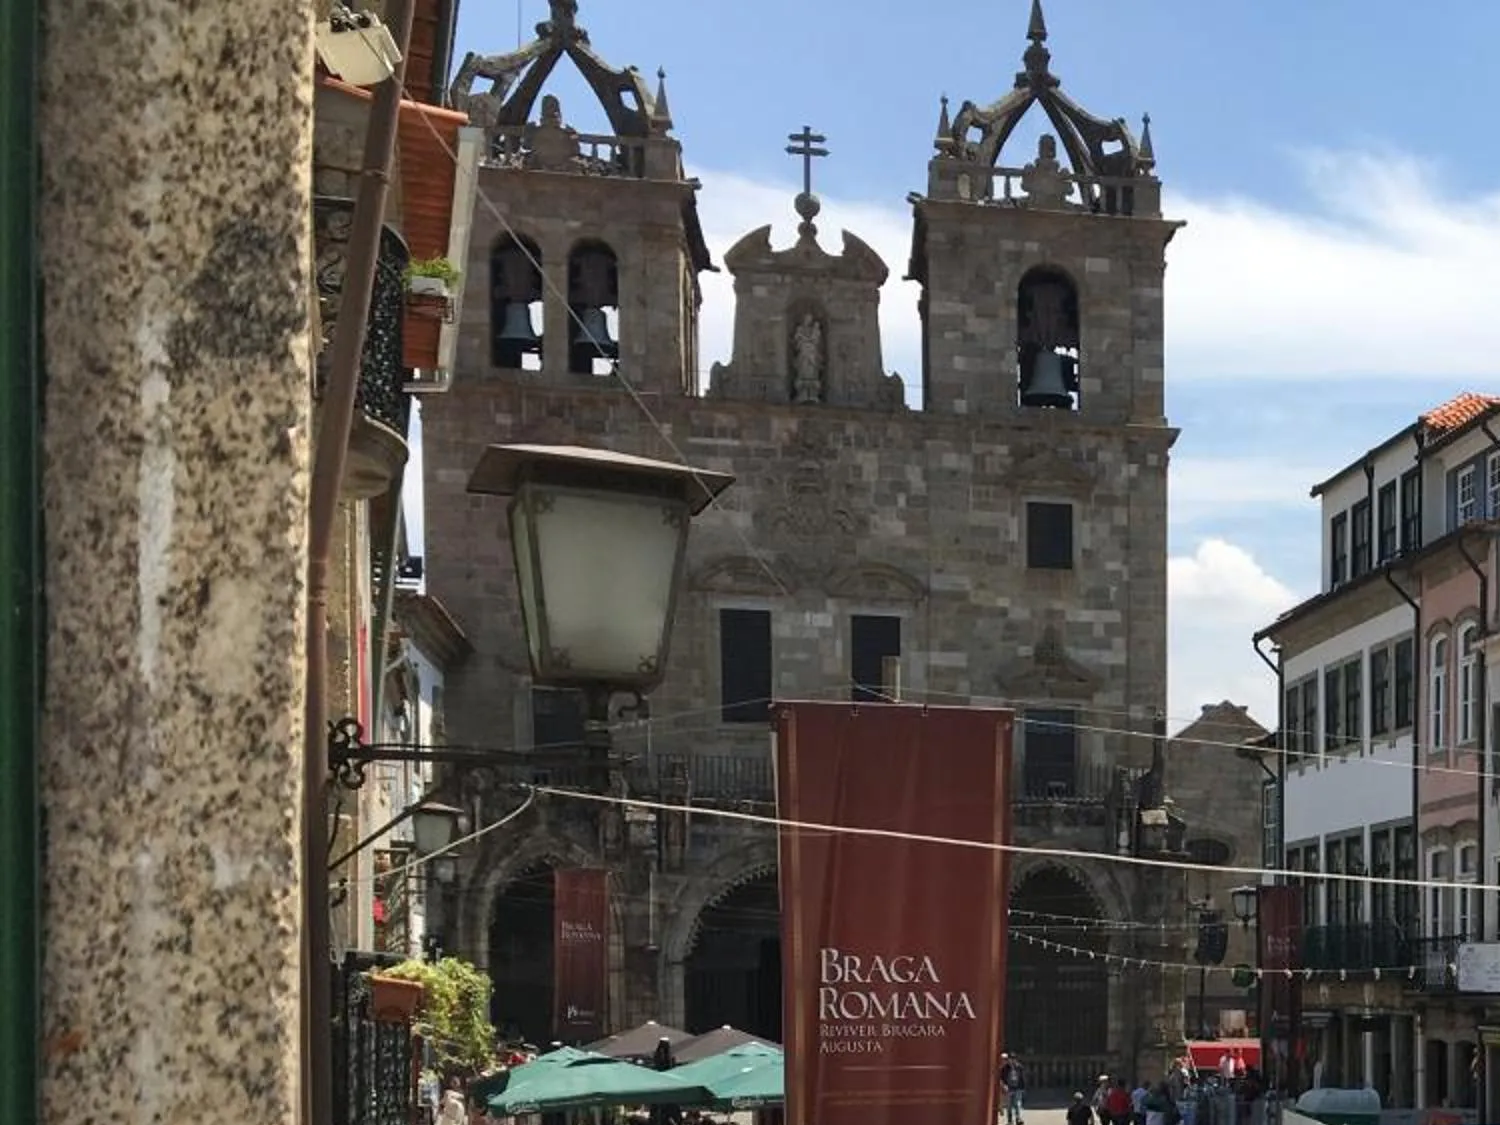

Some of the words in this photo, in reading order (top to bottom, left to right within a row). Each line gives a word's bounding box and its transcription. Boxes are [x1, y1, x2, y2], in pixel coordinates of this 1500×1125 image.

[820, 948, 940, 983] BRAGA
[819, 986, 977, 1020] ROMANA
[819, 1040, 882, 1053] AUGUSTA
